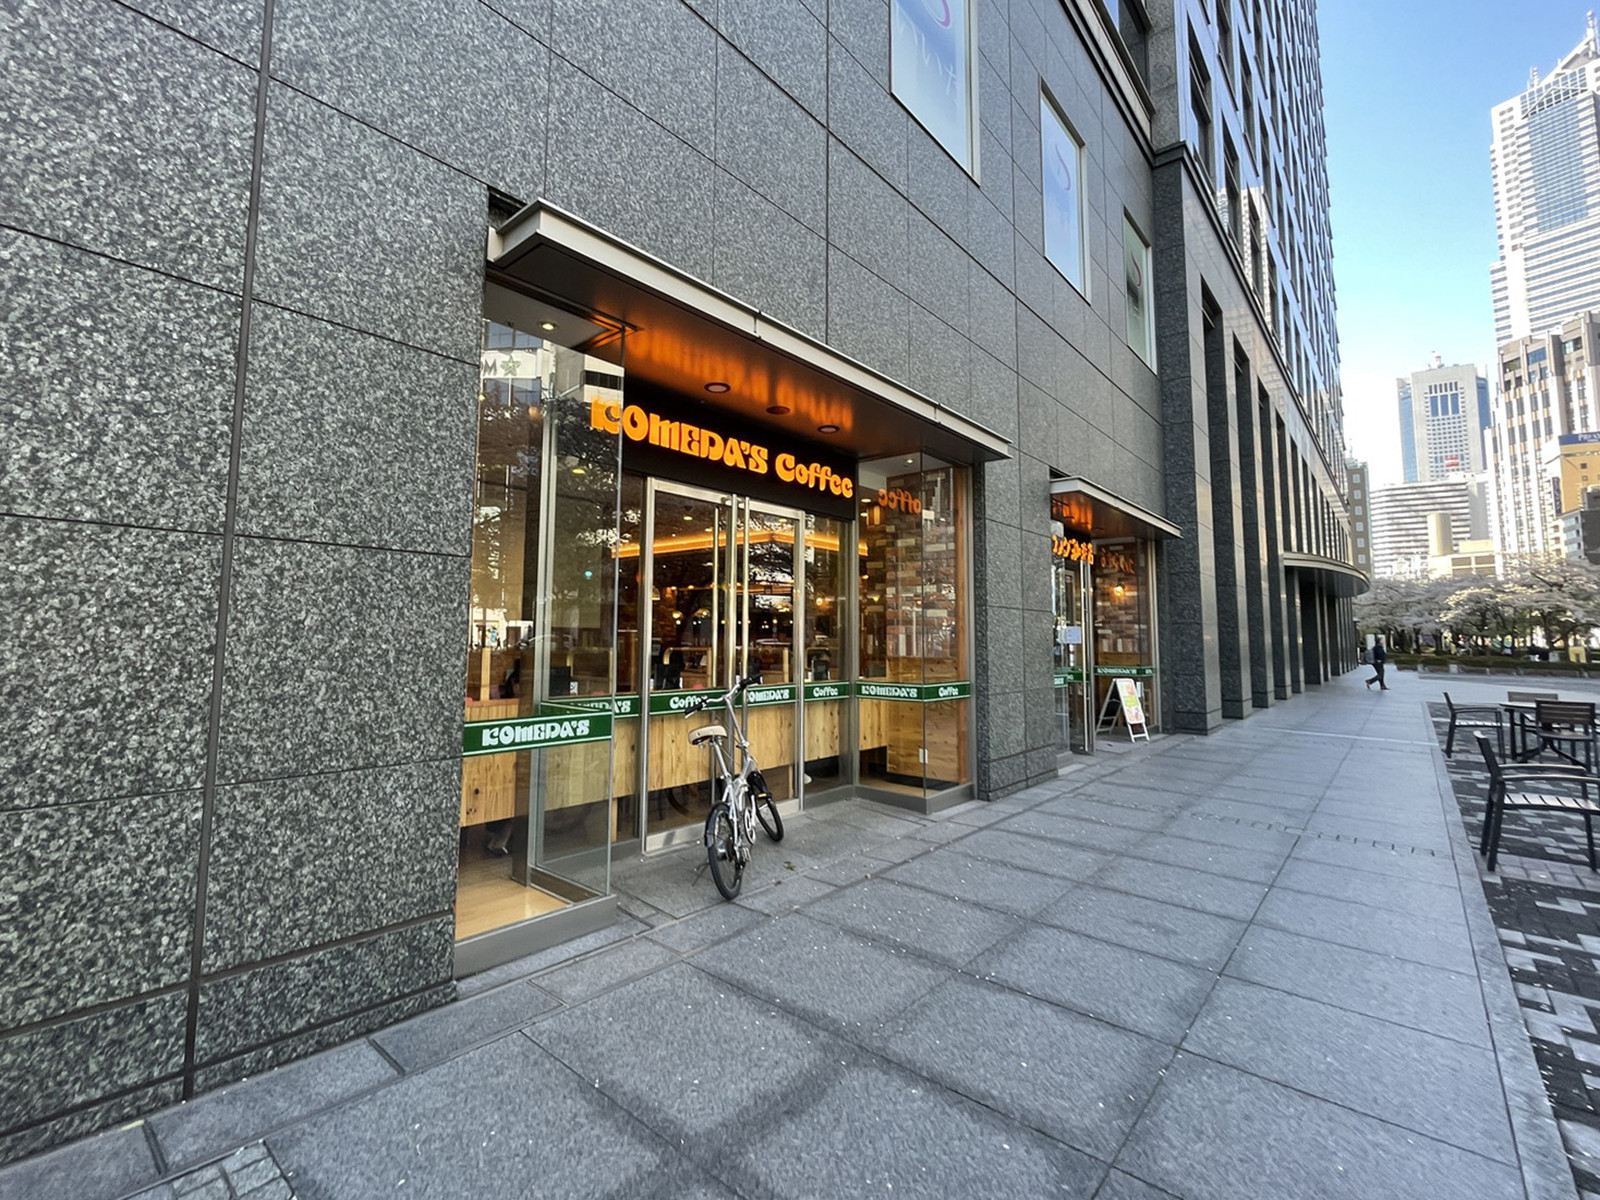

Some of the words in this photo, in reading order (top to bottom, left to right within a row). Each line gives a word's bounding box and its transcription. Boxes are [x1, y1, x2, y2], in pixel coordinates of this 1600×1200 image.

[590, 397, 768, 474] KOMEDA'S
[775, 453, 853, 498] Coffee
[747, 689, 789, 702] OMEDA'S
[813, 687, 839, 698] Coffee
[862, 685, 918, 698] KOMEDA'S
[482, 719, 590, 747] KOMEDA'S
